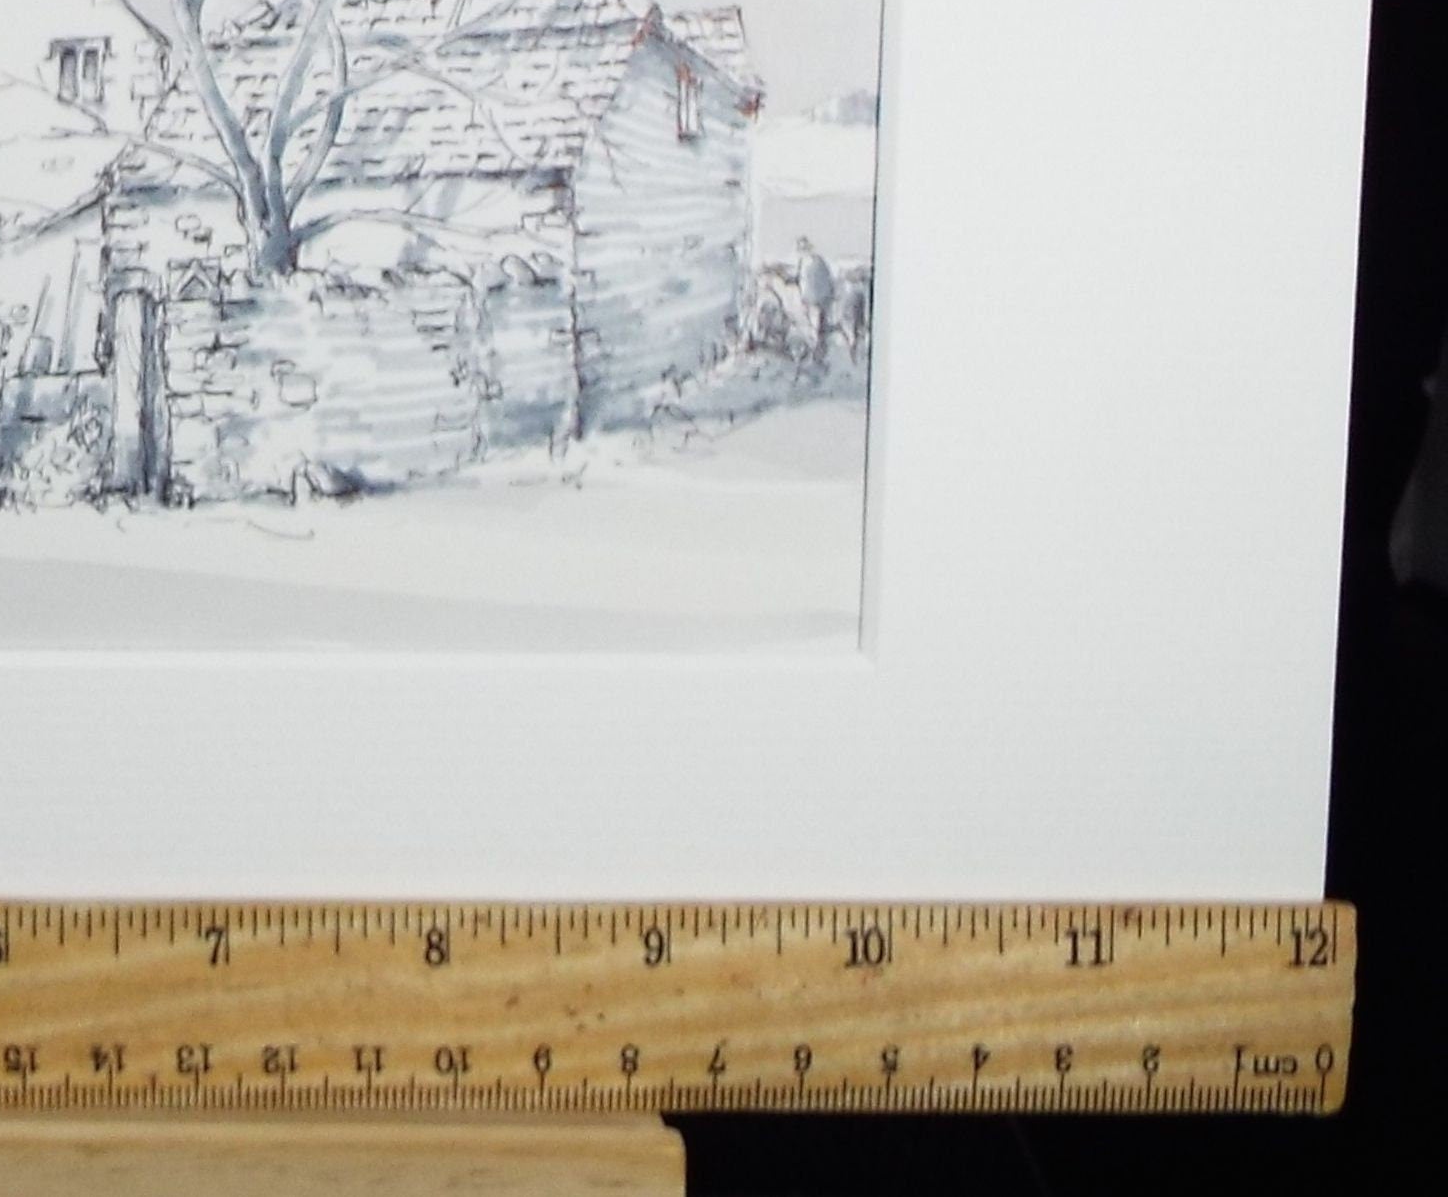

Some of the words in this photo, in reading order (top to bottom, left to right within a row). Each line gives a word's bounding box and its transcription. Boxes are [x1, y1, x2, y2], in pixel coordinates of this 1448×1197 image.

[204, 926, 225, 967] 7
[424, 926, 447, 967] 8
[644, 926, 665, 968] 9
[844, 927, 884, 968] 10
[1064, 927, 1107, 968] 11
[1288, 927, 1328, 968] 12
[4, 1044, 40, 1073] 15
[90, 1044, 126, 1073] 14
[177, 1044, 213, 1073] 13
[262, 1044, 300, 1073] 12
[354, 1044, 386, 1073] 11
[435, 1044, 473, 1074] 10
[533, 1044, 551, 1073] 9
[621, 1044, 640, 1073] 8
[706, 1045, 728, 1074] 7
[793, 1045, 812, 1074] 6
[881, 1045, 900, 1074] 5
[971, 1045, 991, 1074] 4
[1054, 1045, 1073, 1074] 3
[1142, 1045, 1161, 1074] 2
[1234, 1045, 1247, 1074] 1
[1252, 1054, 1298, 1076] cm
[1315, 1045, 1334, 1074] 0
